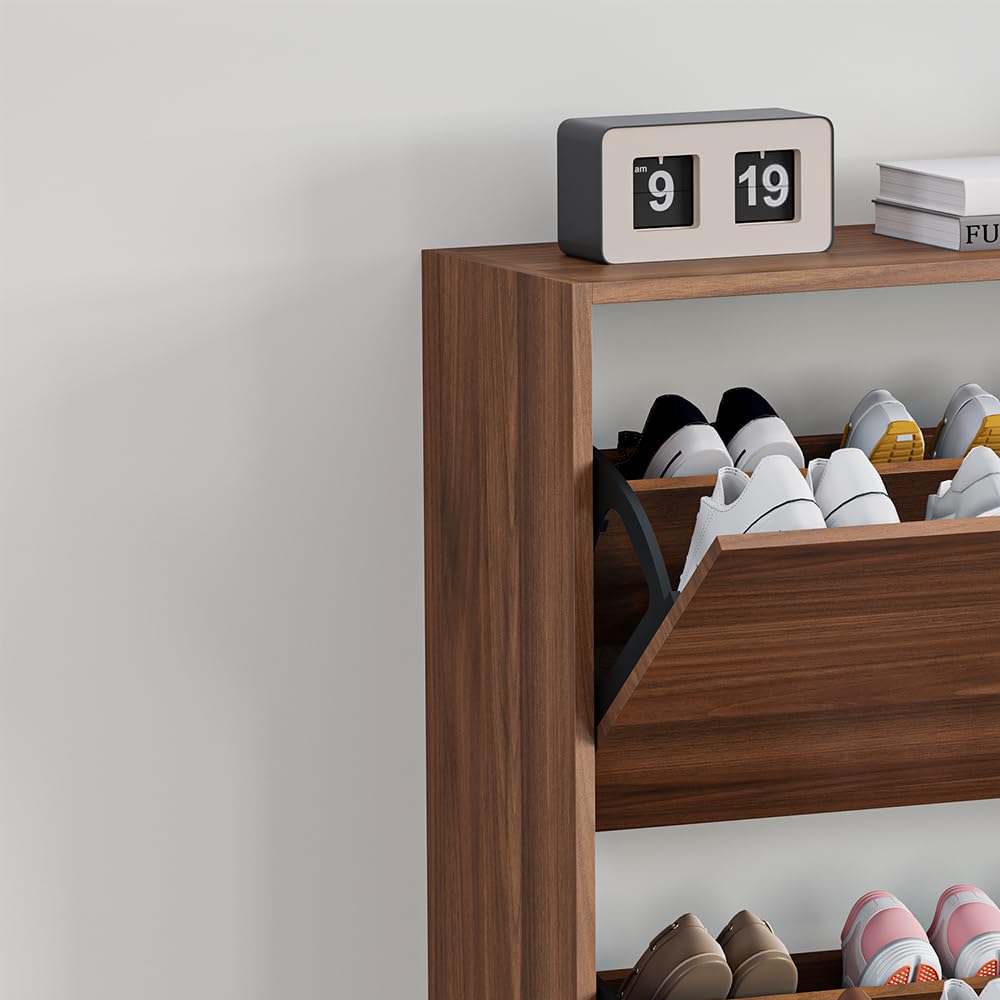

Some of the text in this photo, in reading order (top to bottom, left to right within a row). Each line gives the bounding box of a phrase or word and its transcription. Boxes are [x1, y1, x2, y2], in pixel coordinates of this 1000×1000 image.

[634, 163, 790, 212] am 9 19
